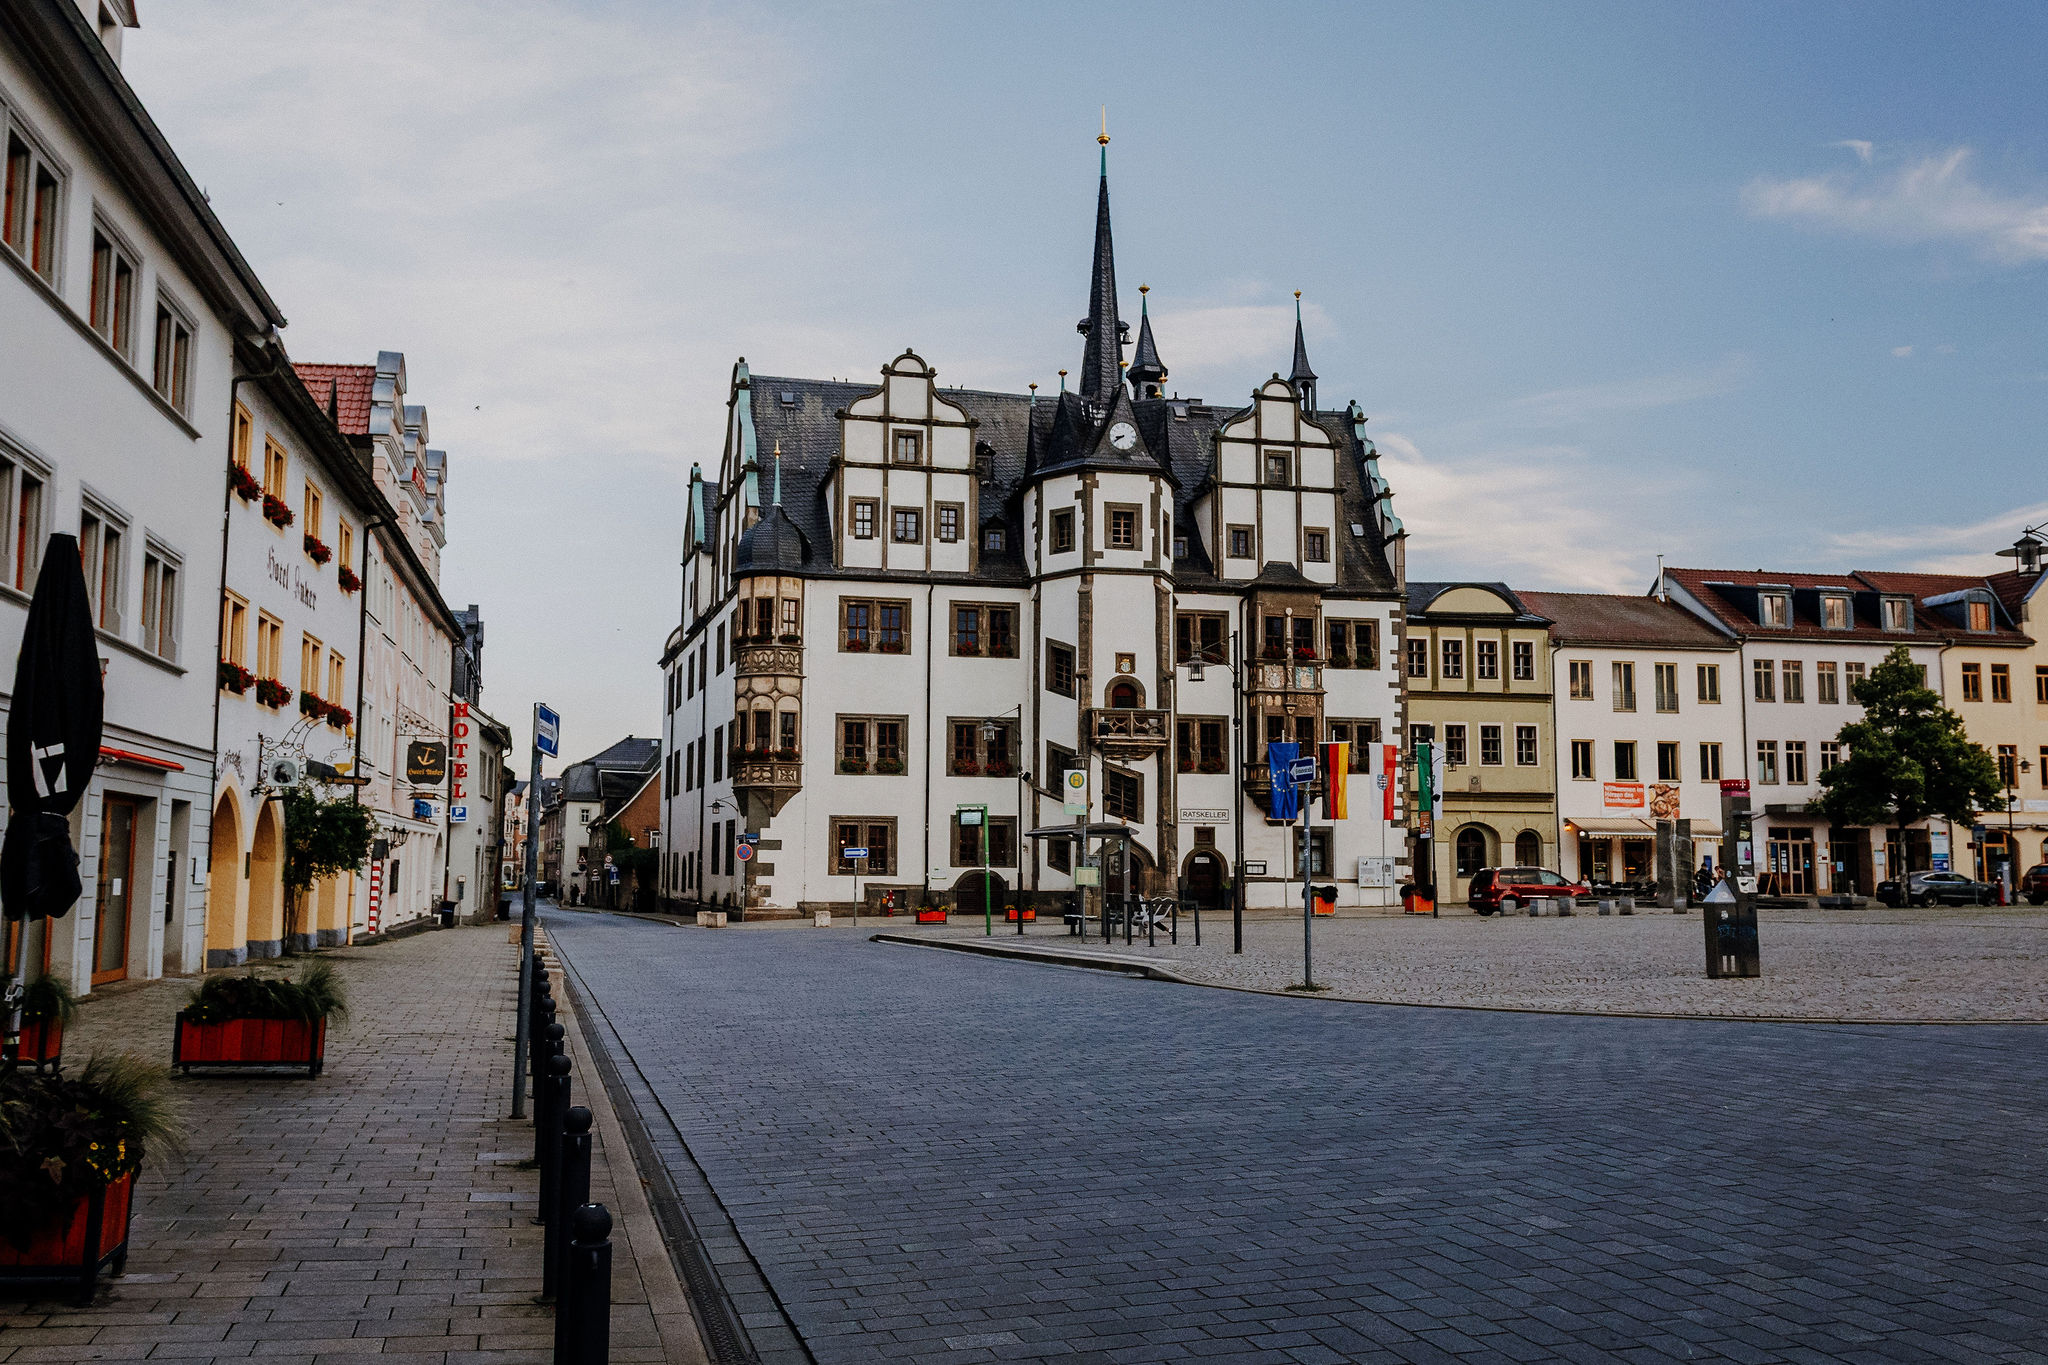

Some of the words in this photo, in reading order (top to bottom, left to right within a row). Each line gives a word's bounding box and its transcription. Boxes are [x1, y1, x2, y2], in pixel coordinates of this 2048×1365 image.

[267, 545, 289, 590] Hotel
[453, 703, 469, 798] HOTEL
[1182, 811, 1227, 819] RATSKELLER
